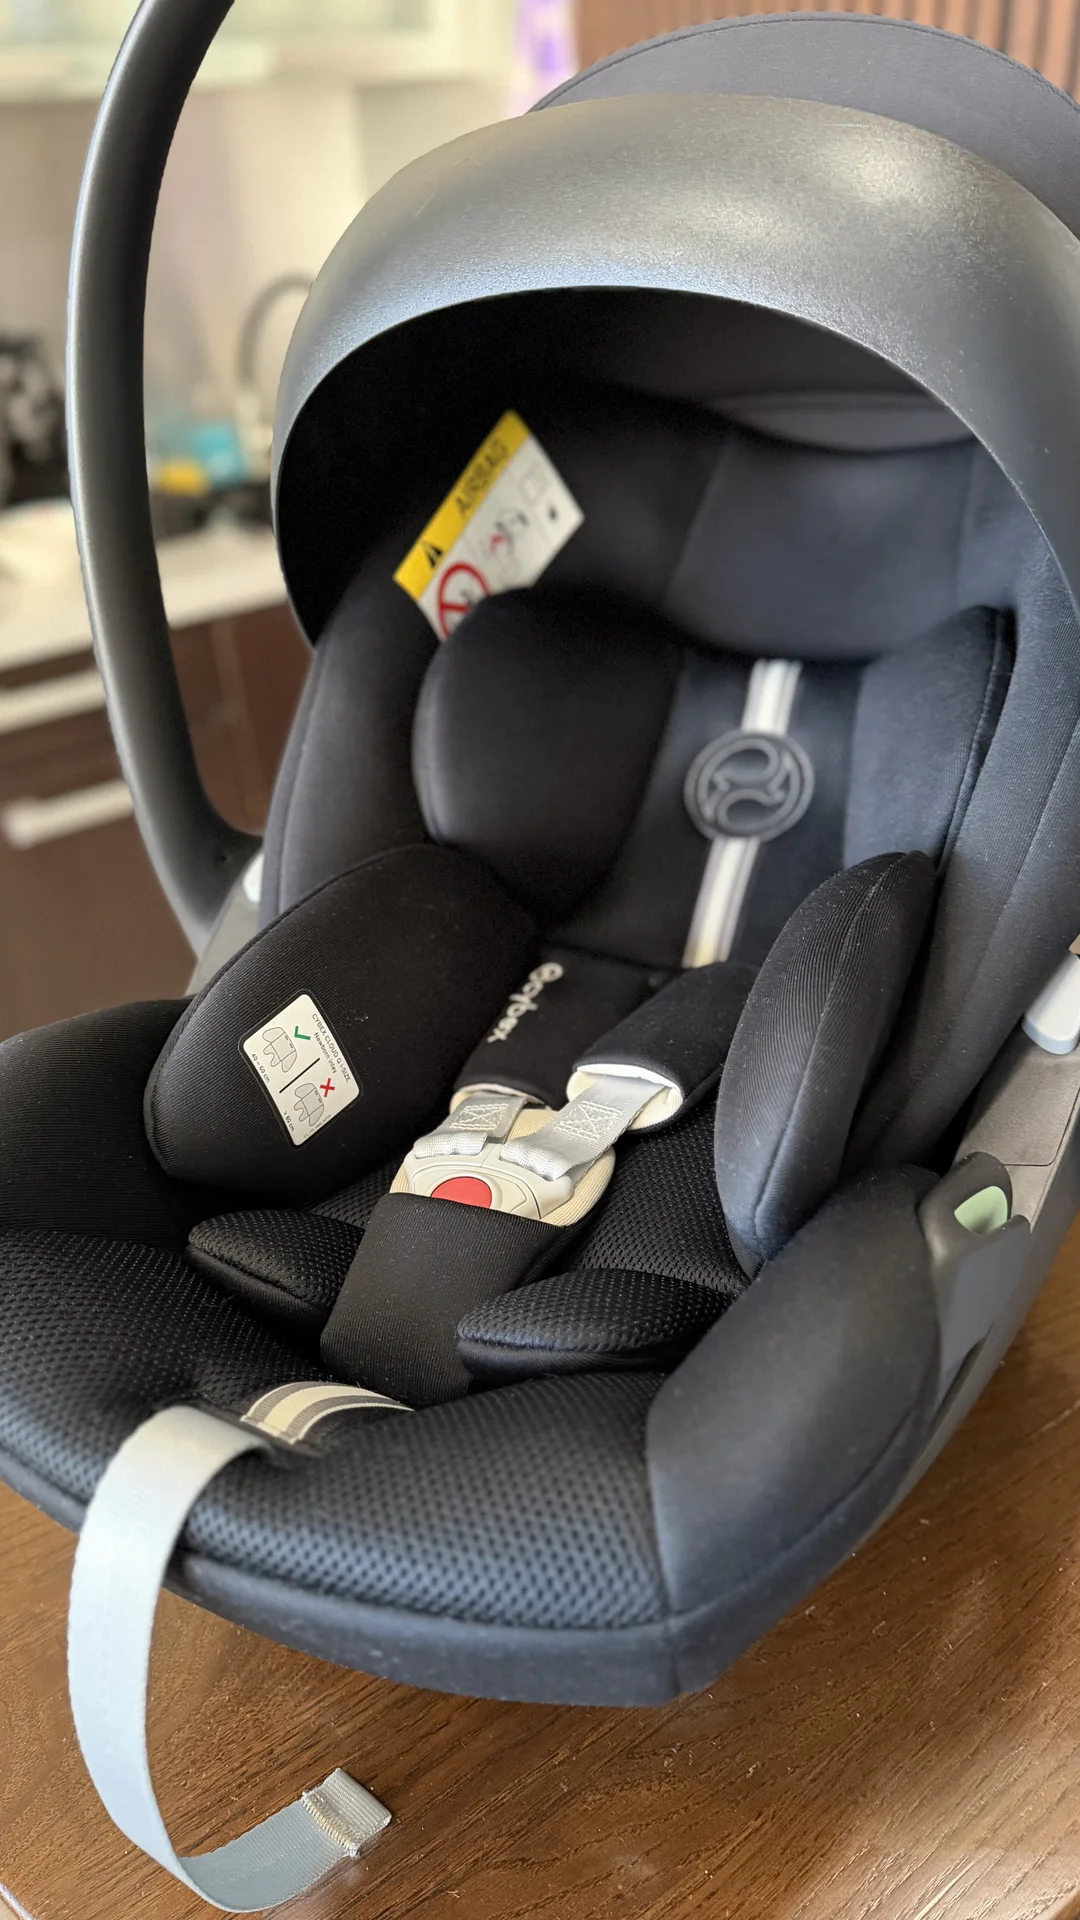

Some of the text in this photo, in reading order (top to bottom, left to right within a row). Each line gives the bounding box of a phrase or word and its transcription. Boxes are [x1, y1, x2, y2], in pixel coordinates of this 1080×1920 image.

[456, 439, 509, 518] AIRBAG
[487, 980, 544, 1043] cybex
[312, 1013, 327, 1036] CYBEX
[324, 1035, 339, 1058] CLOUD
[314, 1031, 330, 1060] Newborn
[251, 1053, 258, 1061] 40
[263, 1073, 271, 1083] cm
[288, 1122, 295, 1132] cm
